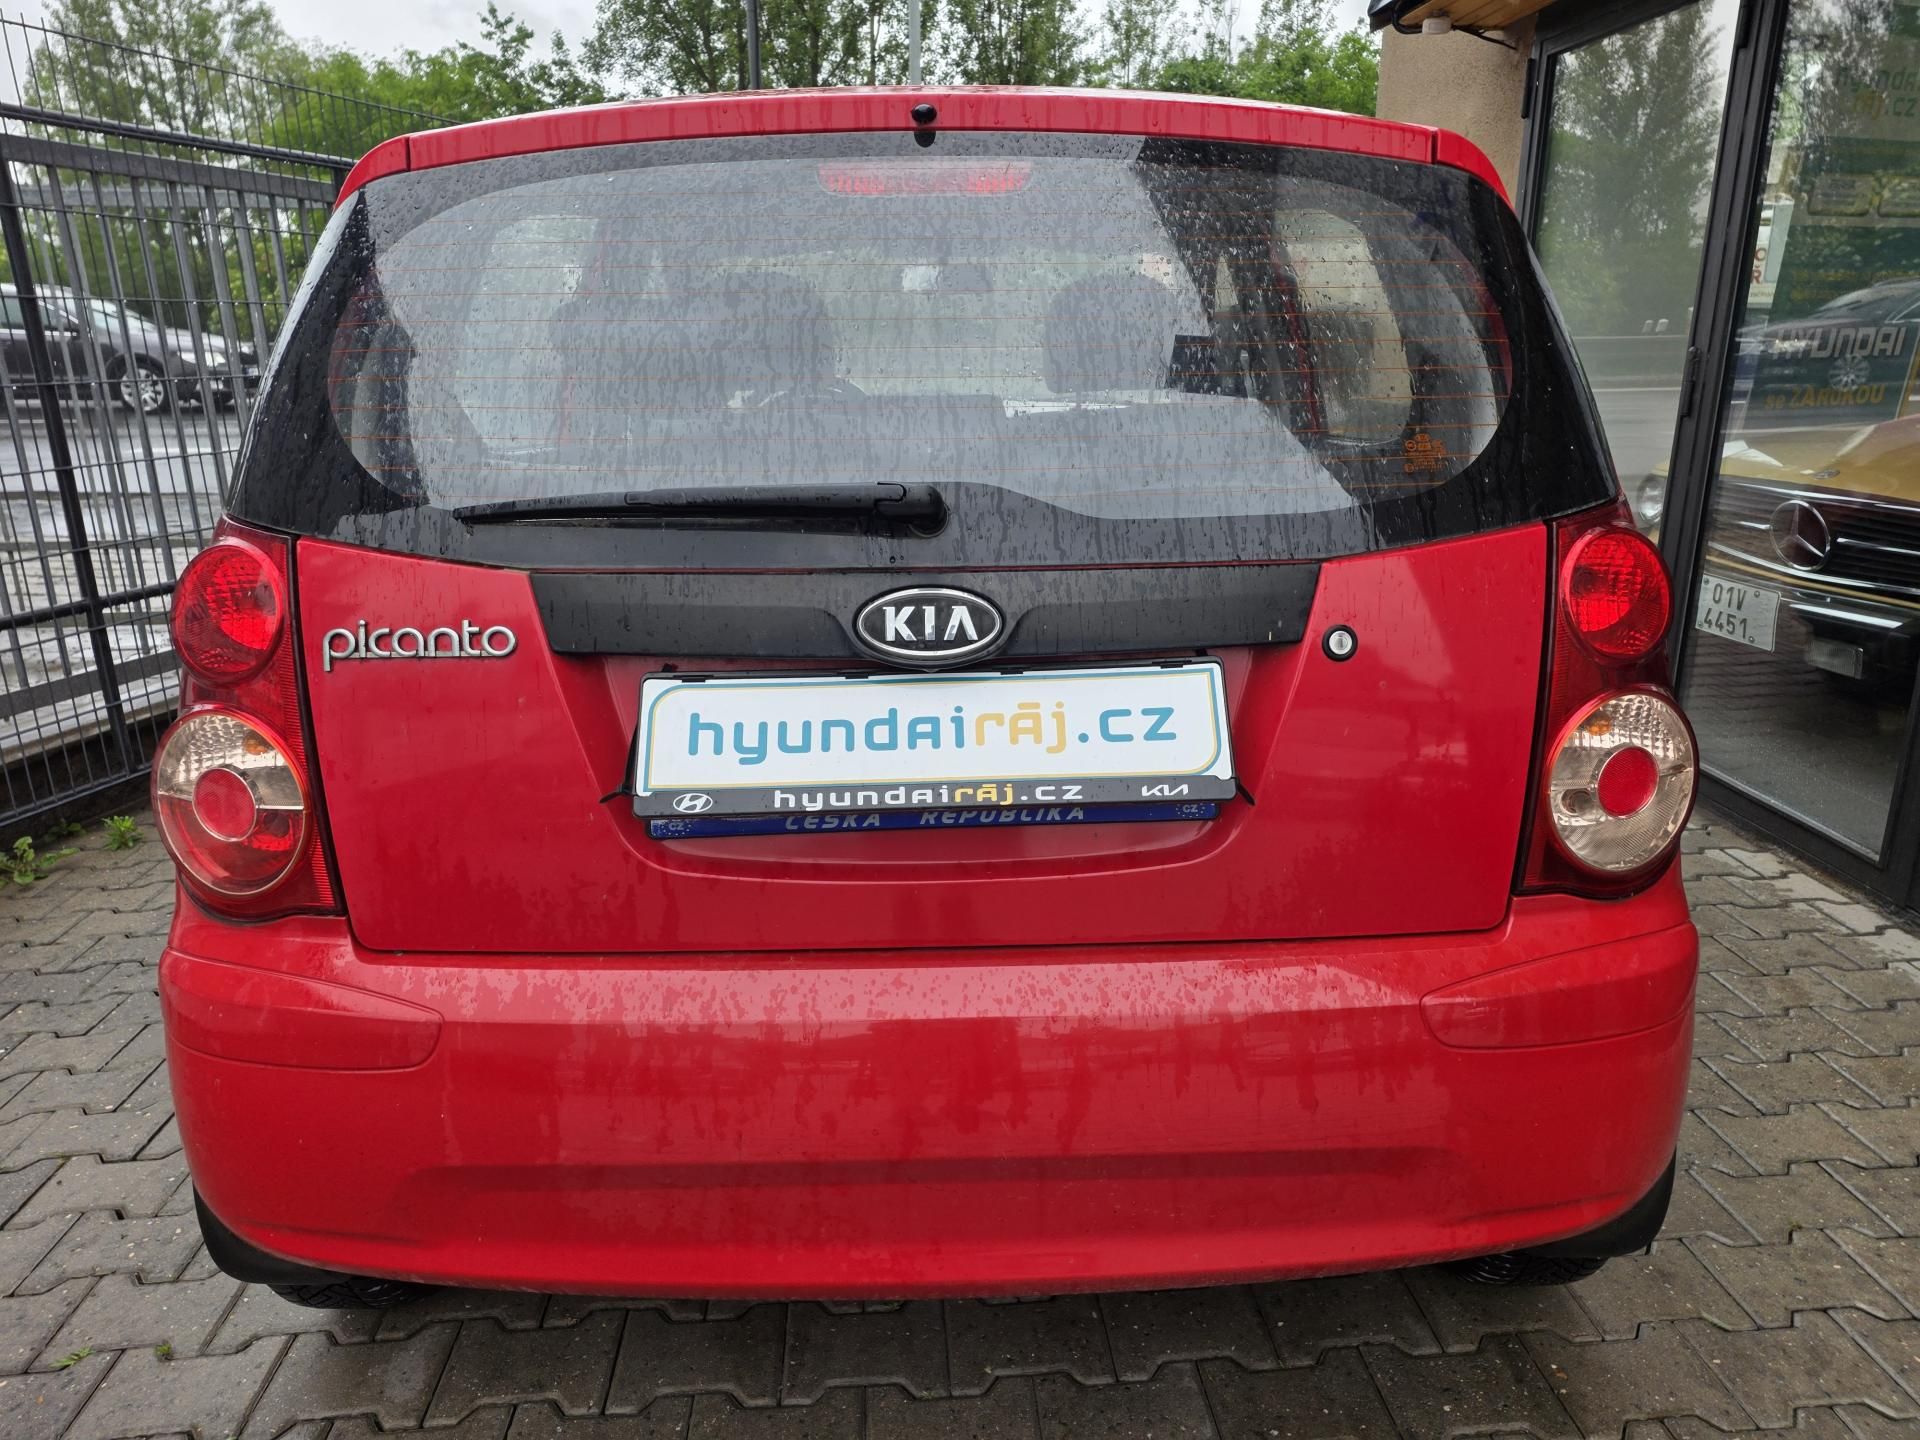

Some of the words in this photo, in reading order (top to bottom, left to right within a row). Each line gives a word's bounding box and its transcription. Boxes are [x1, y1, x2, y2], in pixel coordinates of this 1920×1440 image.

[1772, 326, 1907, 359] HYUNDAI
[1712, 582, 1748, 611] 01V
[882, 605, 979, 642] KIA
[1703, 607, 1749, 639] 4451
[322, 618, 517, 672] picanto
[1182, 803, 1199, 813] CZ
